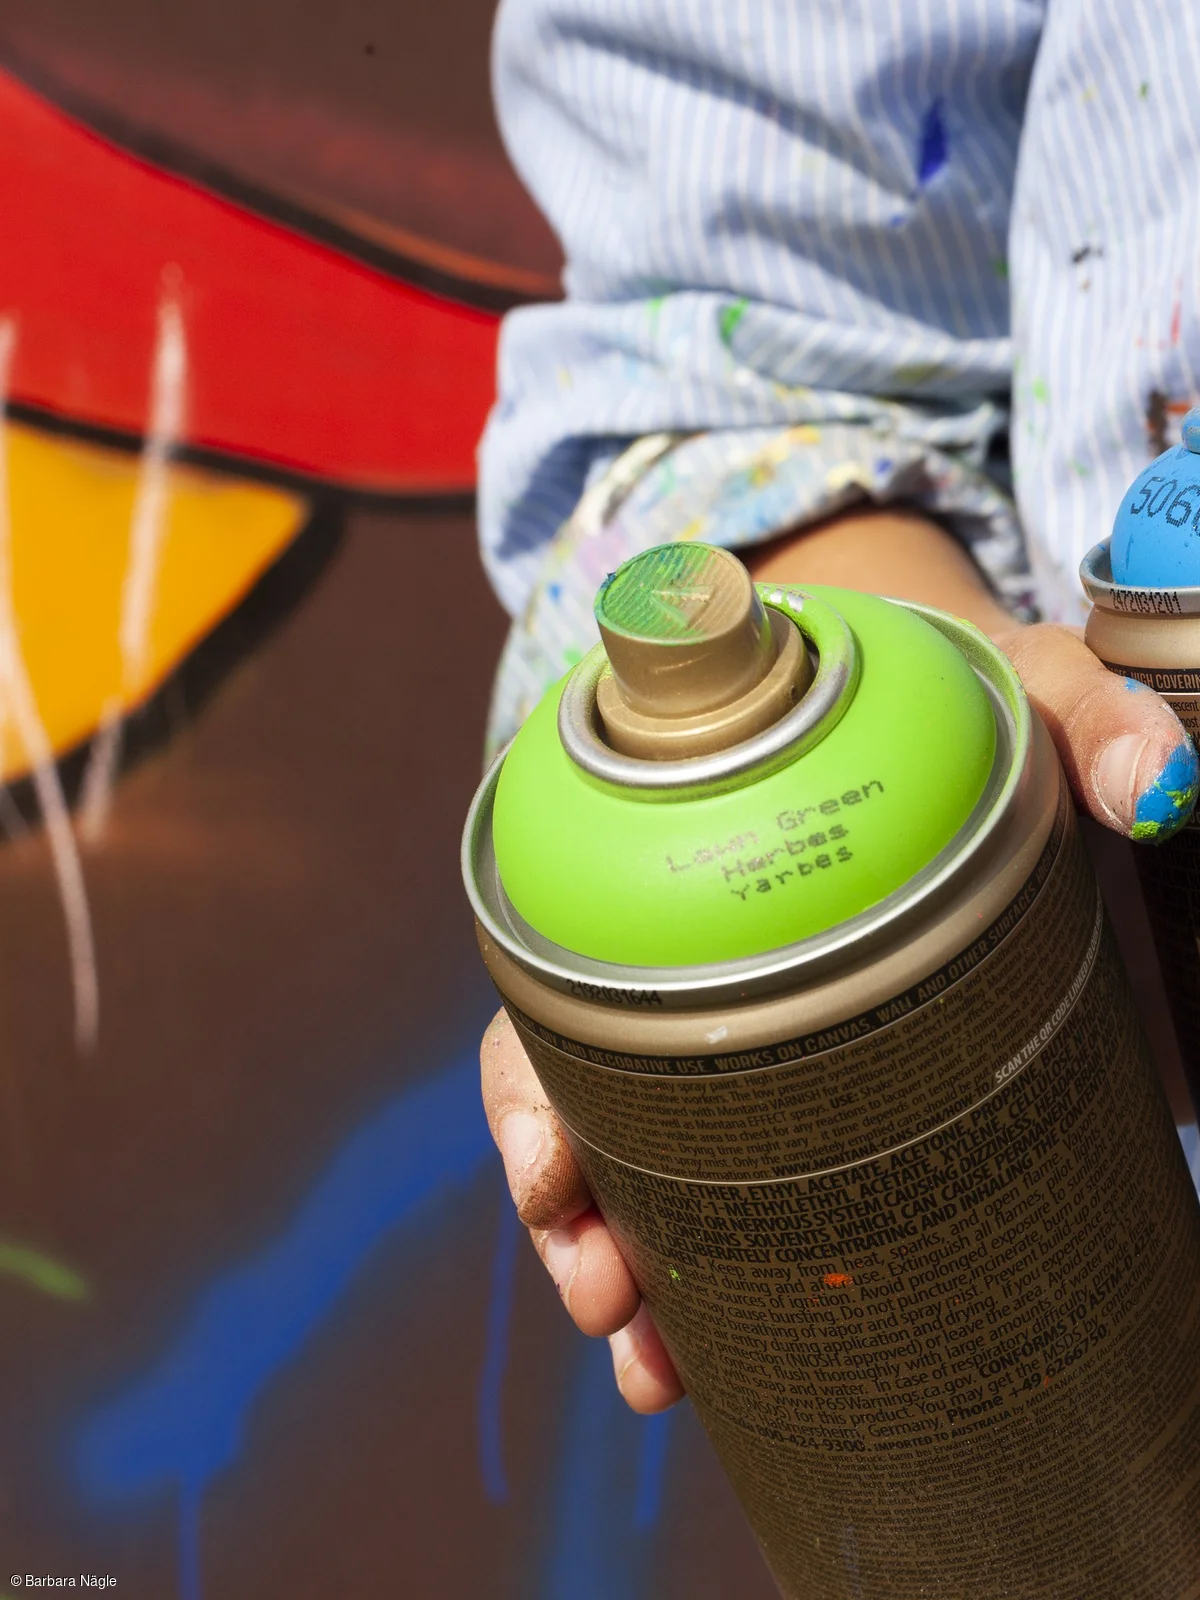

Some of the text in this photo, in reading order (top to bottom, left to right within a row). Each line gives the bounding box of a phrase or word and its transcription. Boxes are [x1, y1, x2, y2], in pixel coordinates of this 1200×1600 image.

[776, 779, 885, 832] Green
[715, 1051, 774, 1072] WORKS
[777, 1043, 801, 1060] ON
[918, 978, 948, 1003] AND
[948, 941, 988, 979] OTHER
[995, 1056, 1022, 1084] SCAN
[1021, 1037, 1041, 1059] THE
